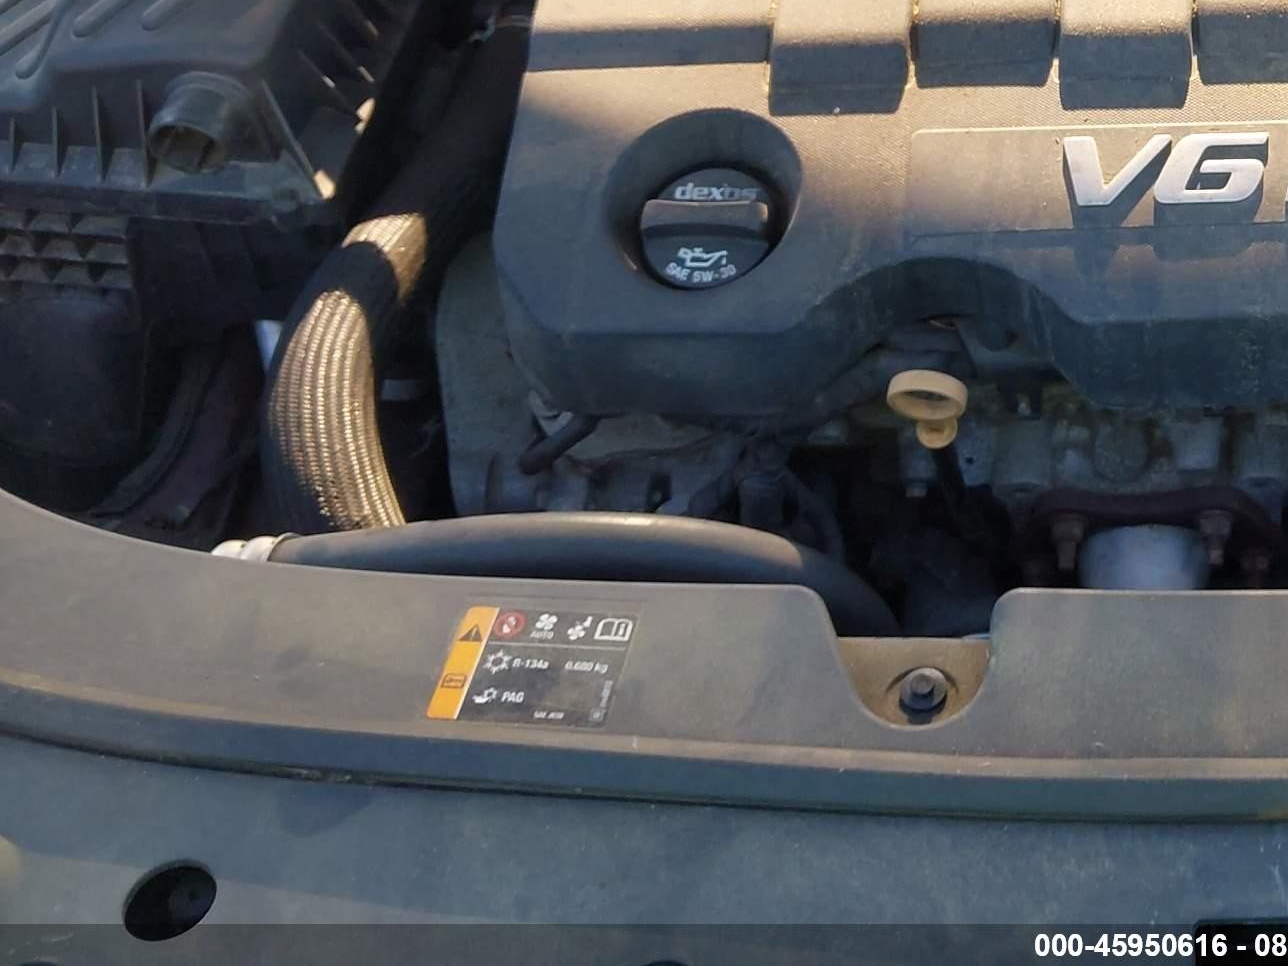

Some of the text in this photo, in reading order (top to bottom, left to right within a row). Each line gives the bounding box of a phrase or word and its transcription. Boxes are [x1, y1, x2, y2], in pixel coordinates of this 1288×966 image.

[1062, 132, 1270, 206] V6
[674, 182, 761, 201] dexos
[665, 262, 736, 282] SAE 5W-30
[594, 662, 608, 674] kg
[501, 691, 524, 703] PAG
